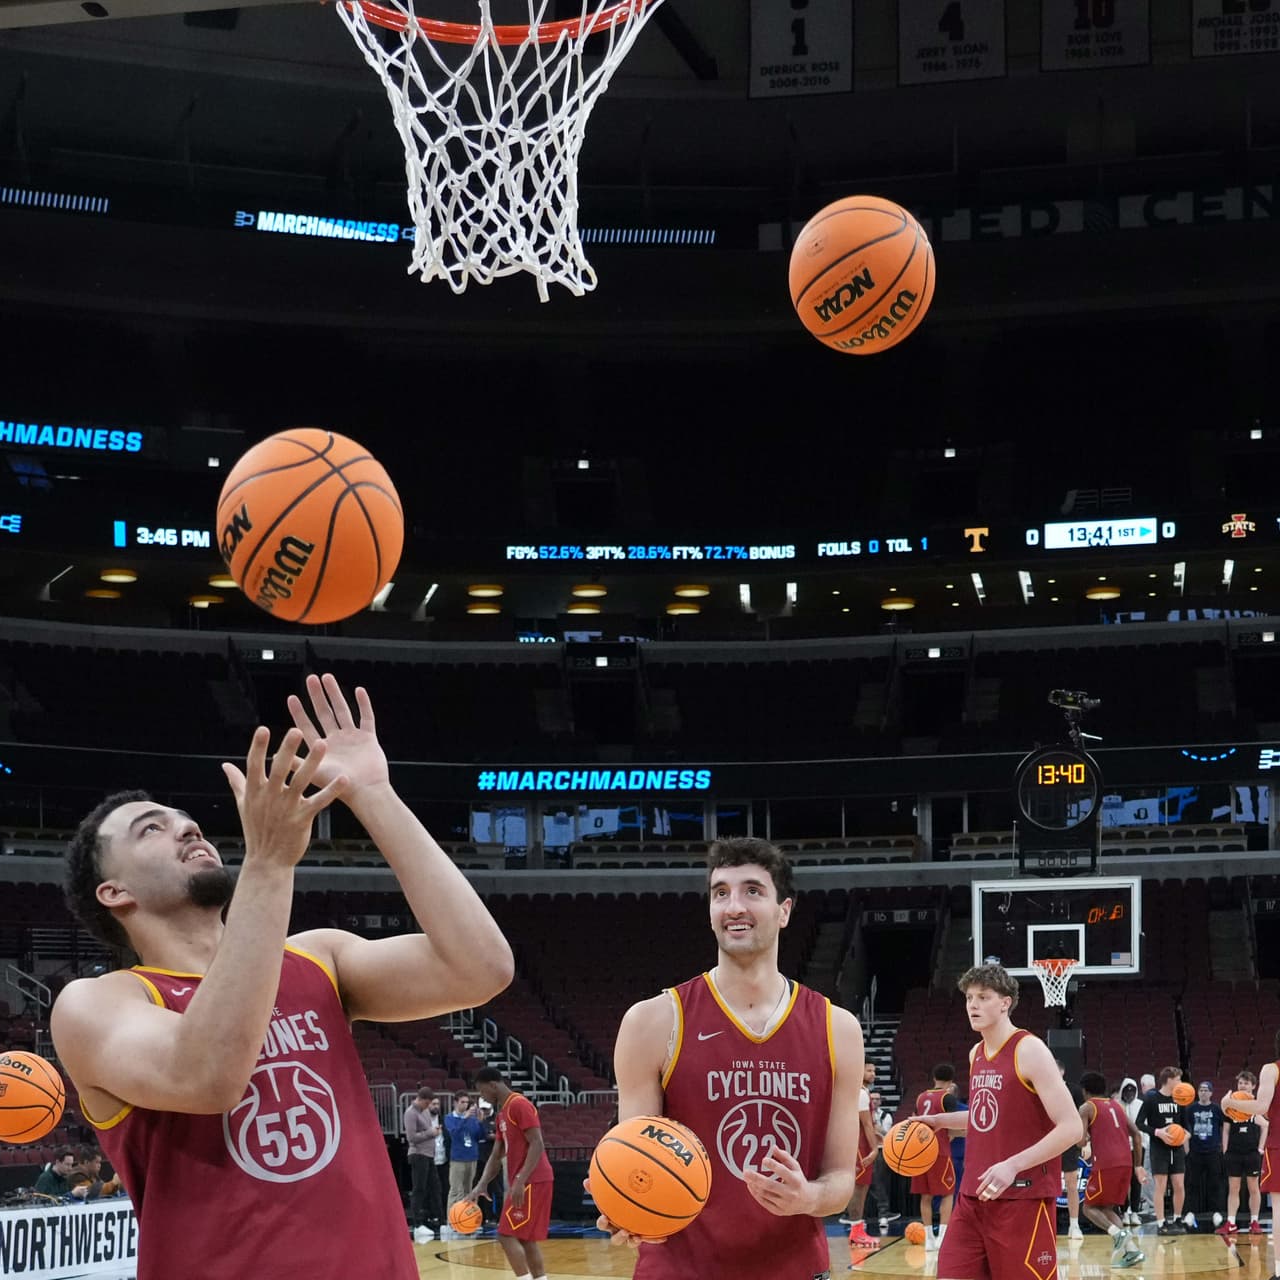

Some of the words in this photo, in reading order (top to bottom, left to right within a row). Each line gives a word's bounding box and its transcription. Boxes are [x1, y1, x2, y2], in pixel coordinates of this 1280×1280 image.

[257, 211, 399, 242] MARCHMADNESS
[814, 267, 876, 323] NCAA
[834, 289, 918, 349] Wilson
[137, 527, 178, 546] 3:46
[182, 530, 210, 547] PM
[964, 527, 989, 553] T
[1068, 526, 1113, 542] 13:41
[507, 546, 538, 559] FG%
[539, 546, 583, 559] 52.6%
[586, 546, 625, 559] 3PT%
[673, 546, 703, 559] FT%
[705, 546, 748, 559] 72.7%
[749, 545, 795, 559] BONUS
[818, 541, 861, 556] FOULS
[886, 539, 912, 552] TOL
[921, 537, 928, 550] 1
[478, 770, 711, 790] #MARCHMADNESS
[1038, 764, 1085, 784] 13:40
[732, 1061, 754, 1069] IOWA
[759, 1061, 786, 1070] STATE
[707, 1070, 811, 1103] CYCLONES
[971, 1074, 1003, 1091] CYCLONES
[980, 1105, 987, 1126] 4
[1109, 1107, 1120, 1128] 1
[1157, 1103, 1178, 1114] UNITY
[256, 1105, 318, 1168] 55
[639, 1124, 696, 1168] NCAA
